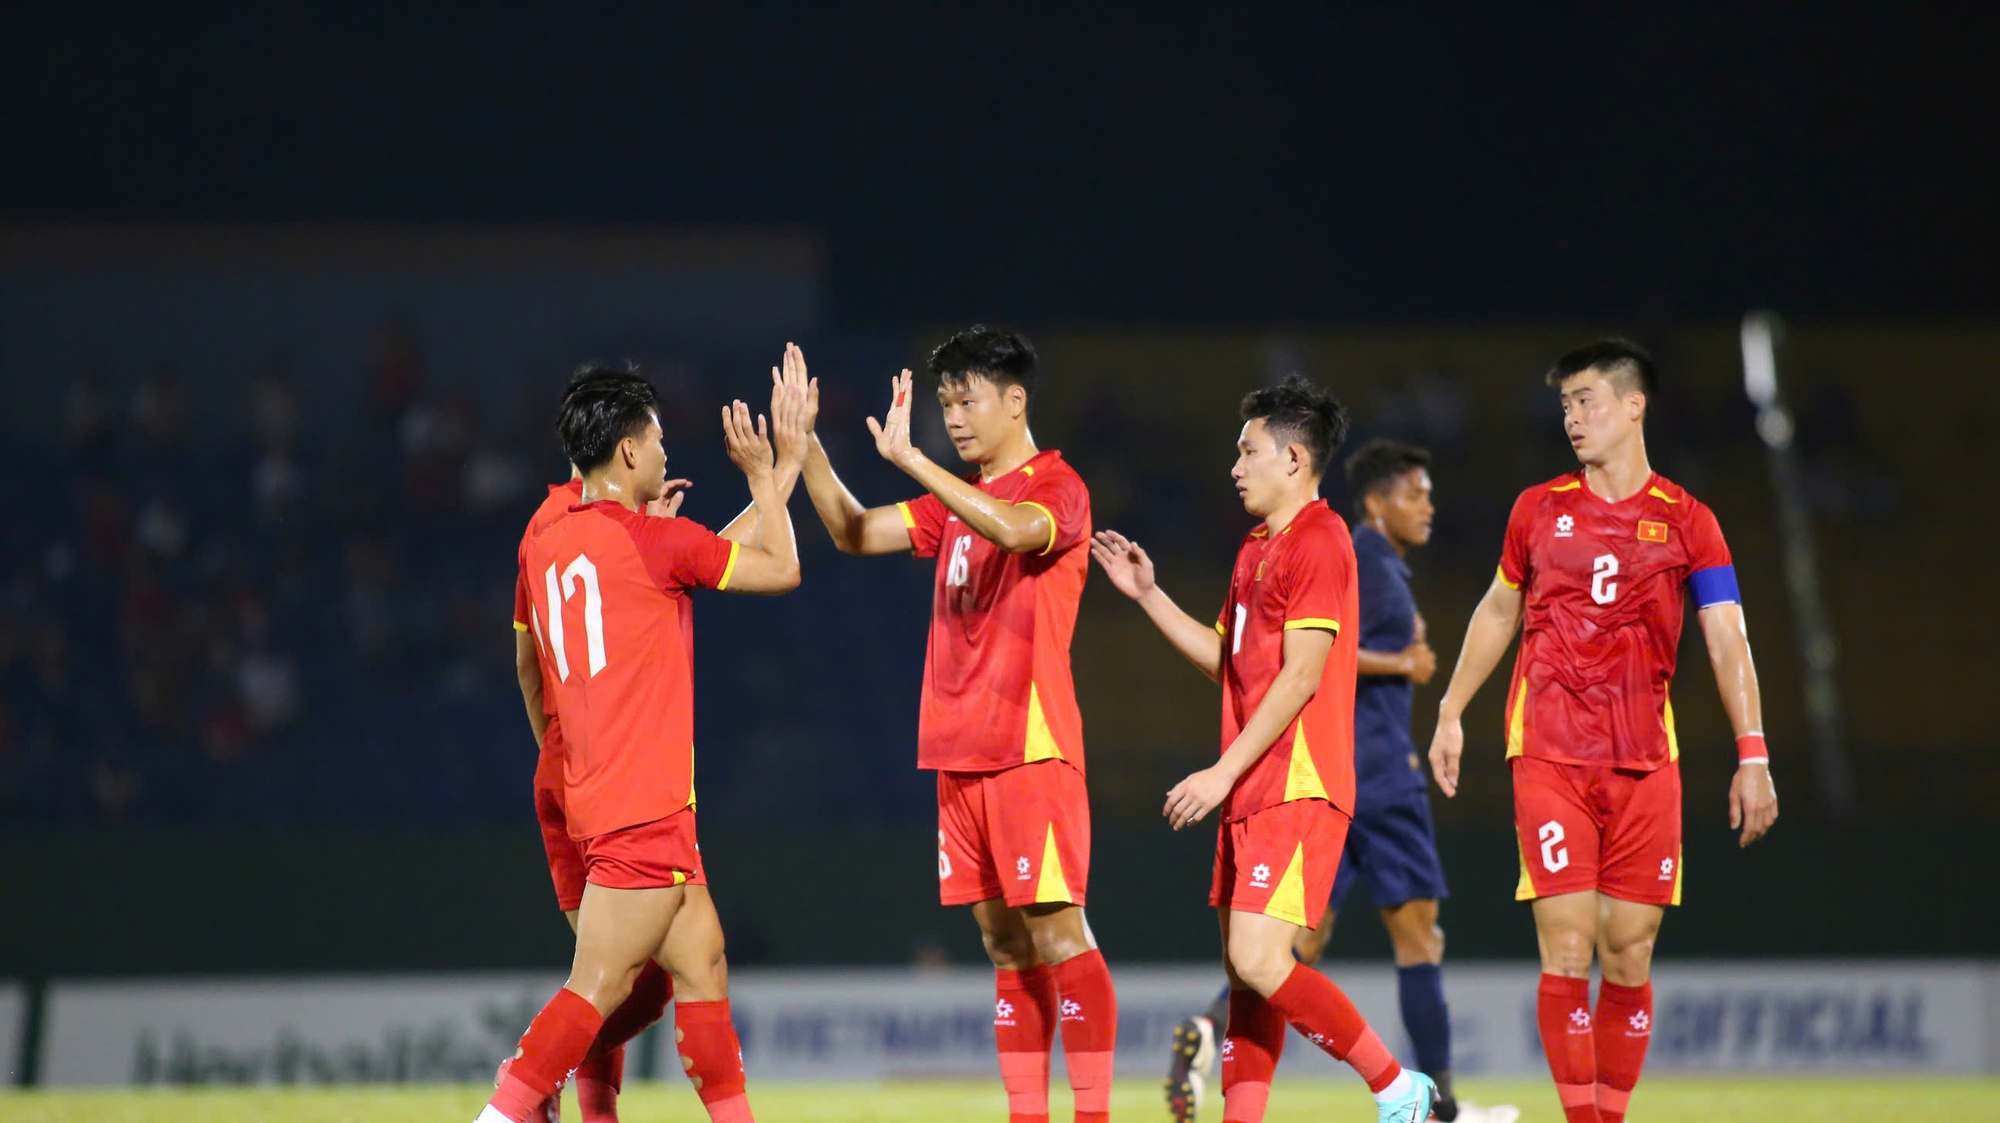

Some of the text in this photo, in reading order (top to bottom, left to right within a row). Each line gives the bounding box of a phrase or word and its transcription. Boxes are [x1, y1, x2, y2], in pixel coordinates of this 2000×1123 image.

[946, 534, 972, 588] 16
[1591, 553, 1620, 605] 2
[544, 552, 608, 685] 17
[1538, 820, 1570, 875] 2
